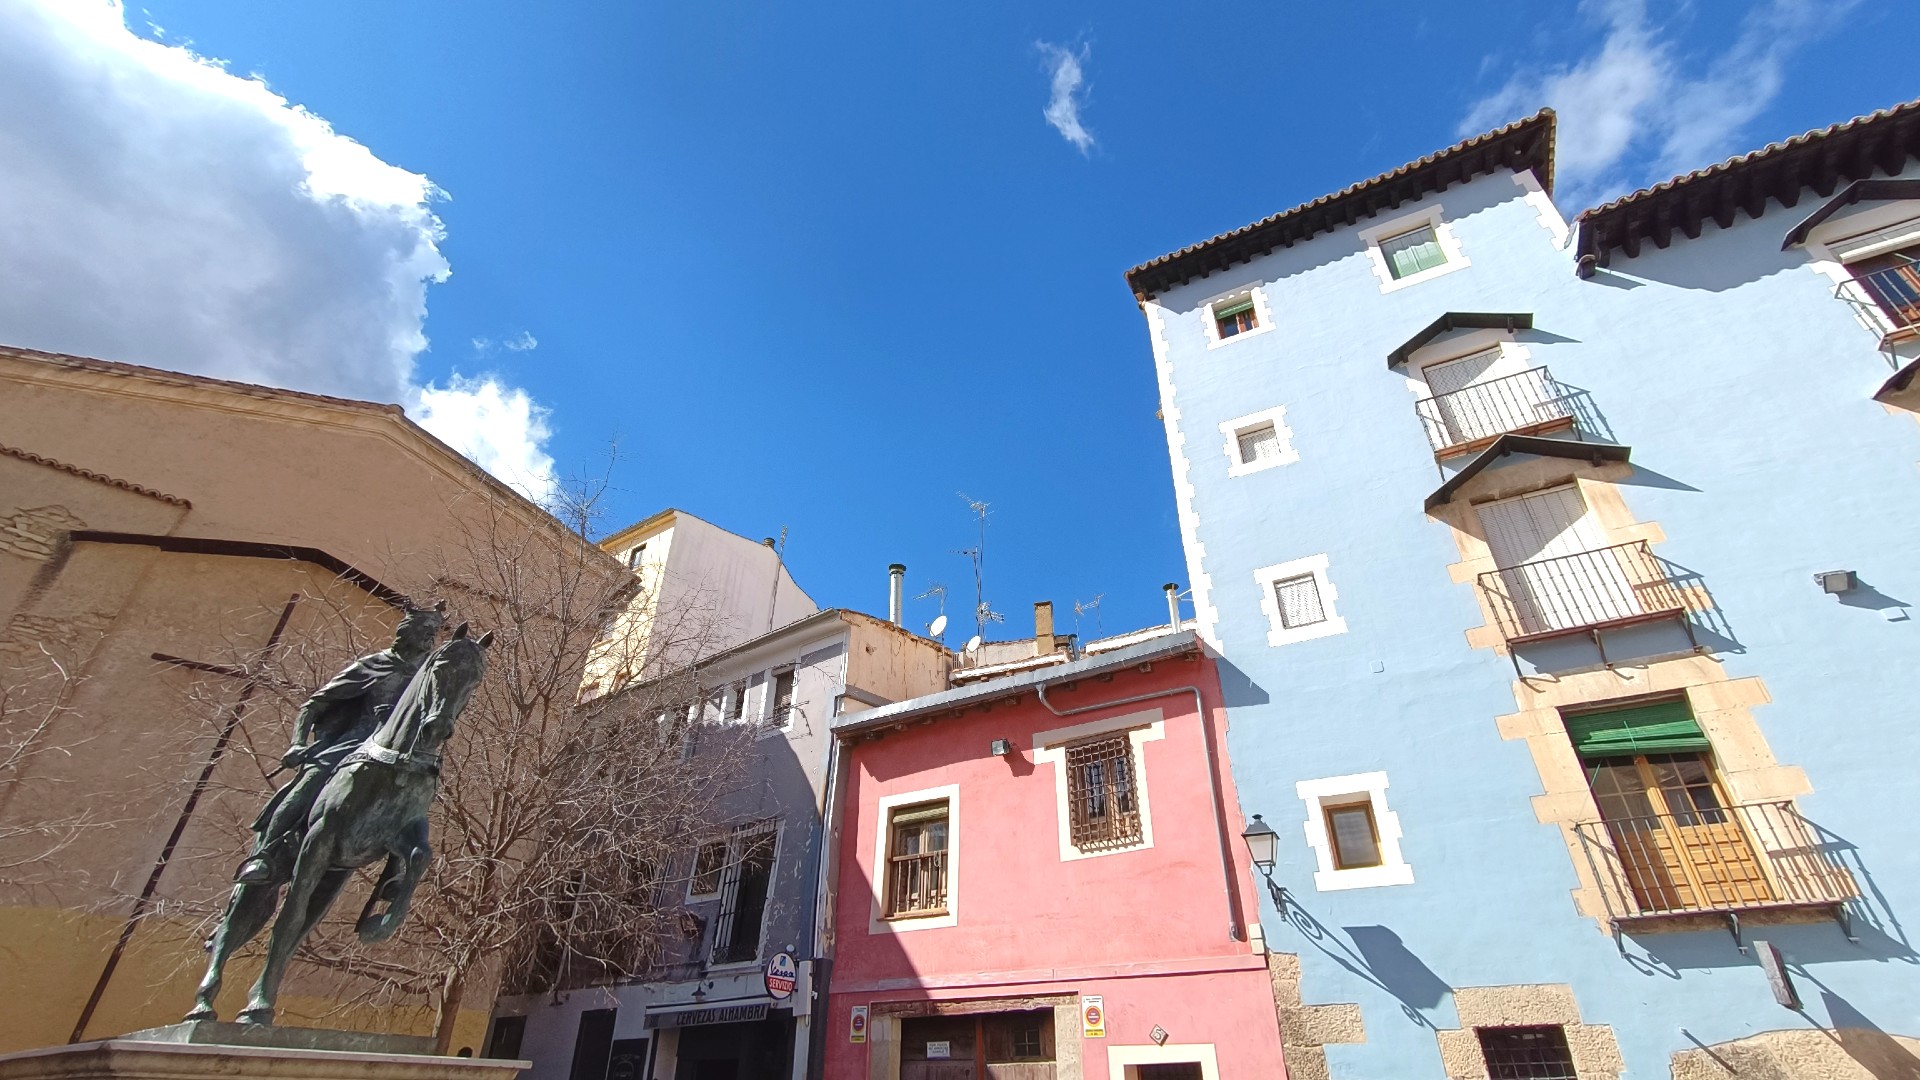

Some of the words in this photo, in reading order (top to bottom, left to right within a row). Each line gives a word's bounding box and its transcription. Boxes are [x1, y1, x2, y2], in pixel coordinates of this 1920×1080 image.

[770, 960, 795, 978] Vespa
[769, 978, 793, 991] SERVIZIO
[676, 1010, 715, 1025] CERVEZAS
[718, 1005, 765, 1021] ALHAMBRA
[1153, 1028, 1162, 1040] 5
